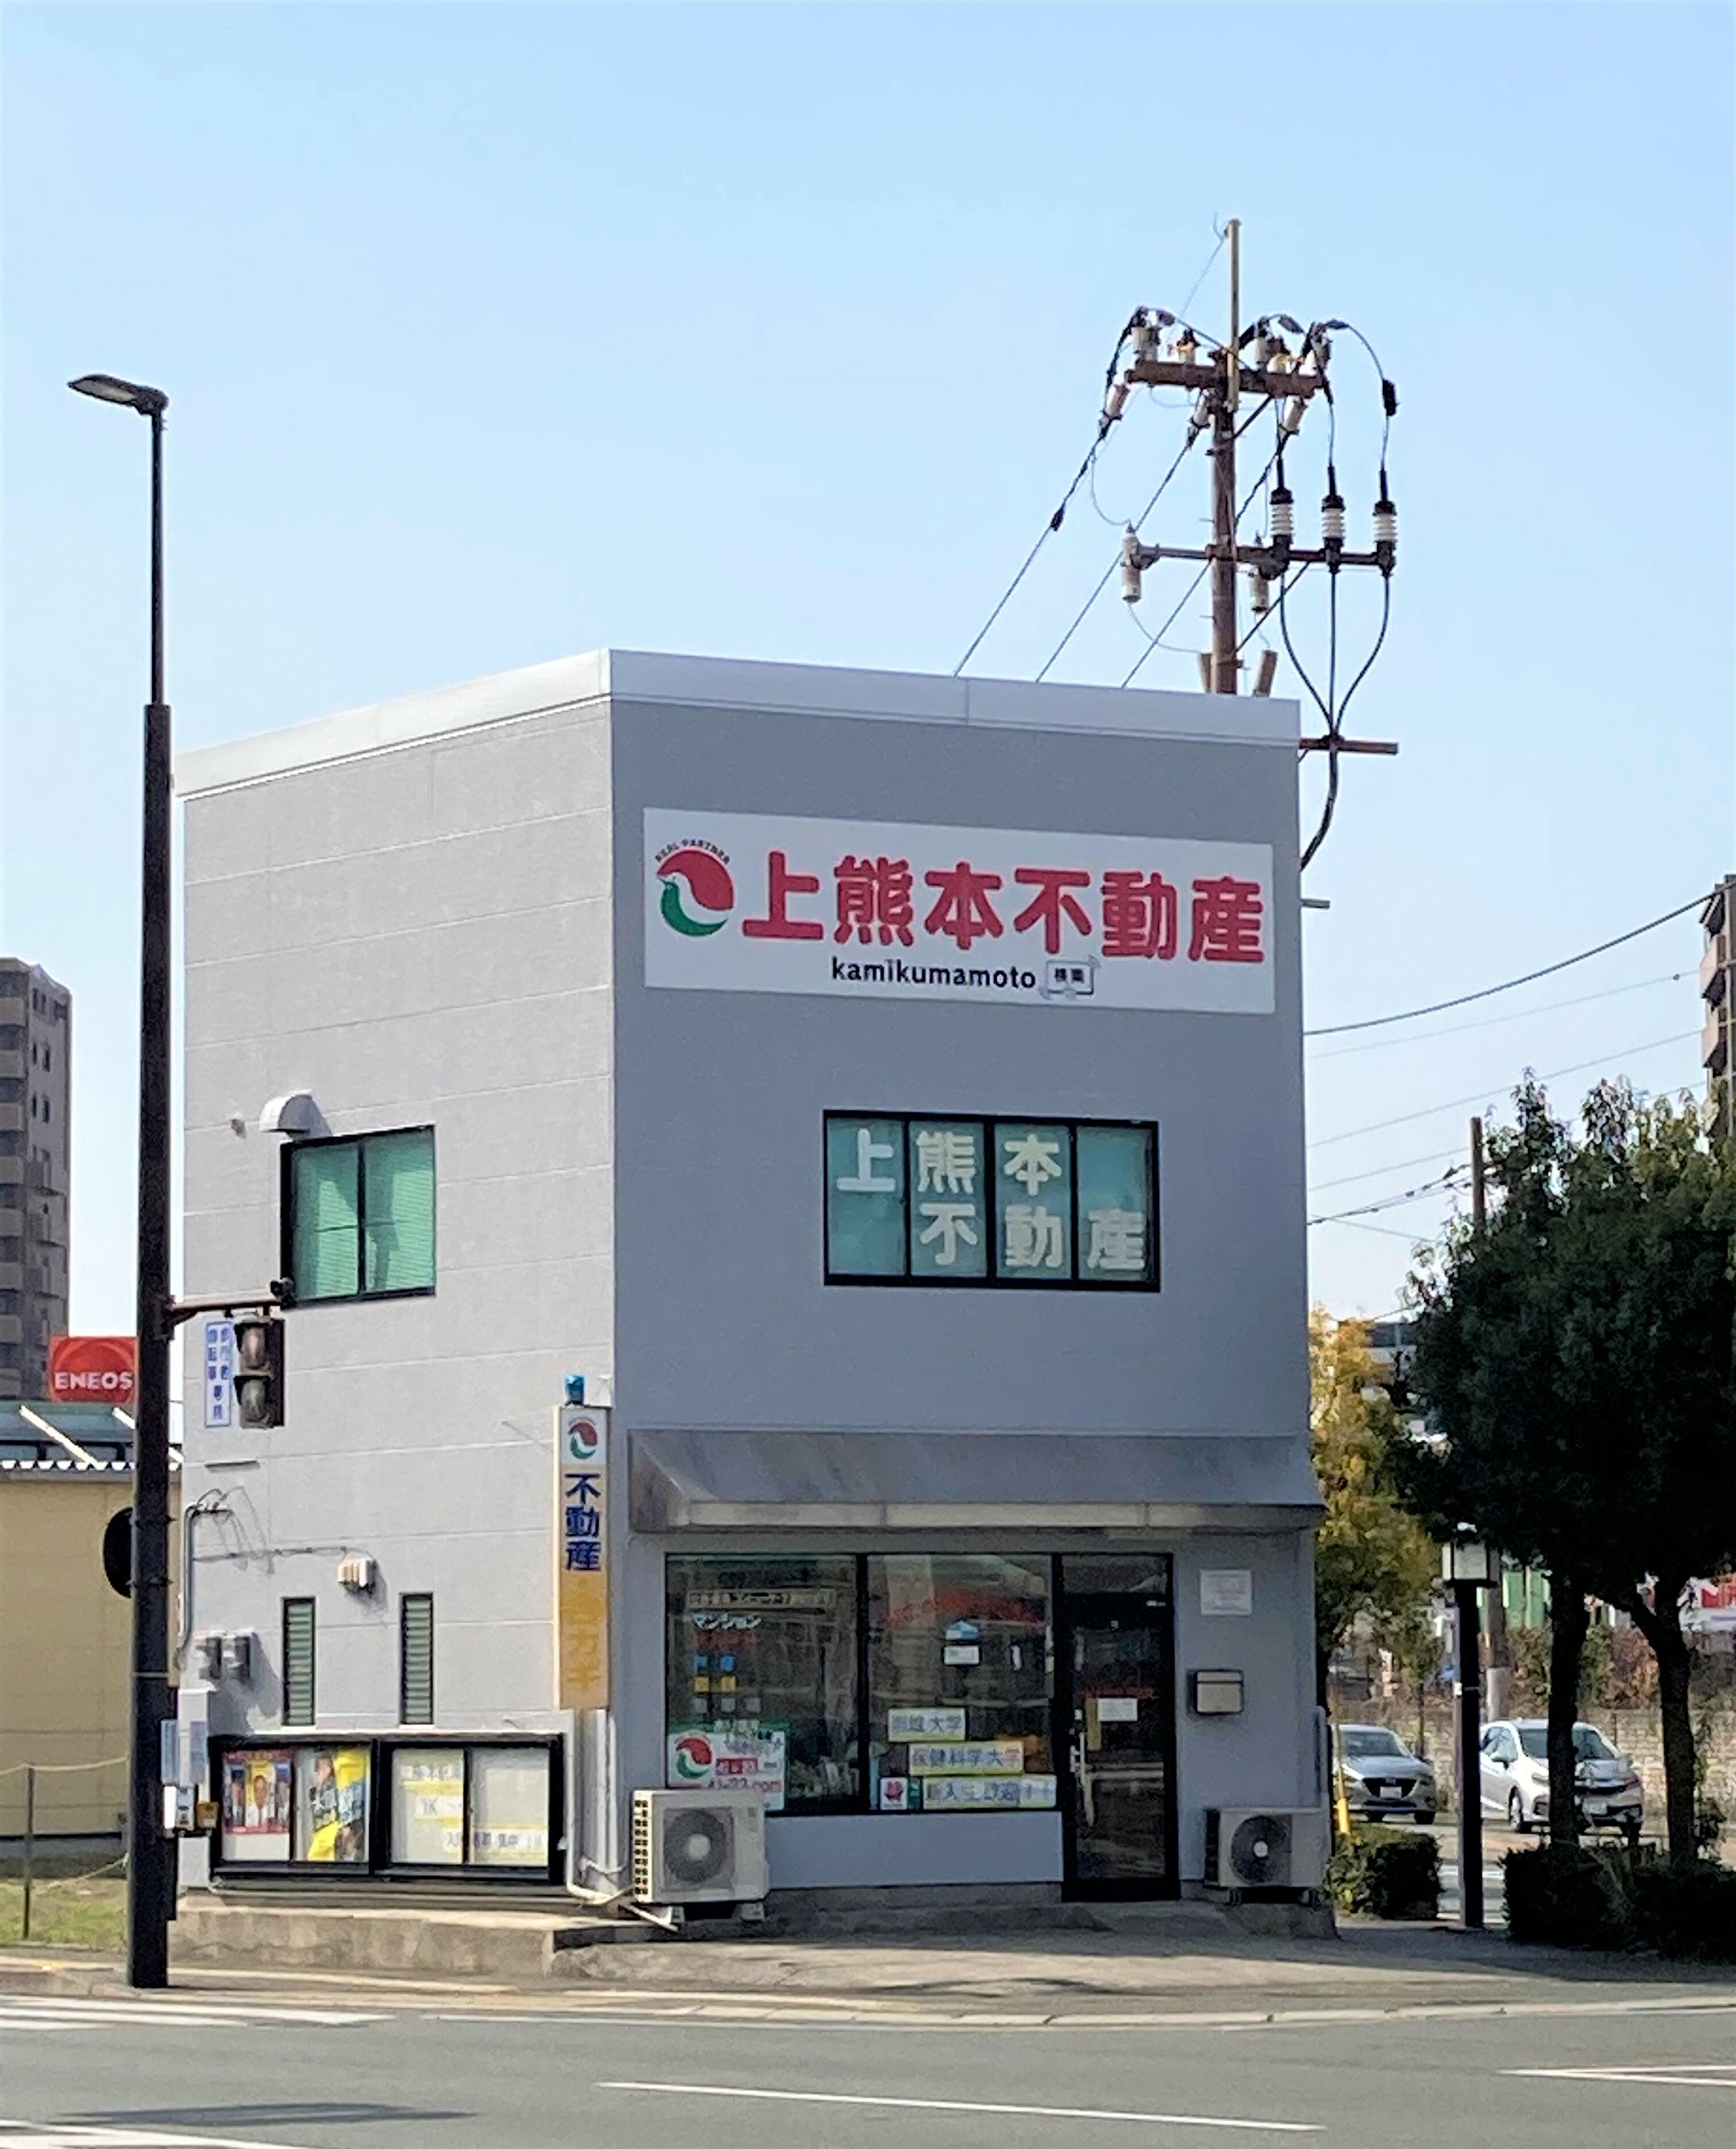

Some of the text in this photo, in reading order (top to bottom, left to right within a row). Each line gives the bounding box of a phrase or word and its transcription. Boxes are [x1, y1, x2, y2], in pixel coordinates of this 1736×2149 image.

[742, 851, 1265, 963] 上熊本不動産
[832, 956, 1036, 989] kamikumamoto
[836, 1128, 1062, 1196] 上熊本
[919, 1203, 1146, 1271] 不動産
[55, 1371, 133, 1390] ENEOS
[565, 1473, 601, 1571] 不動産
